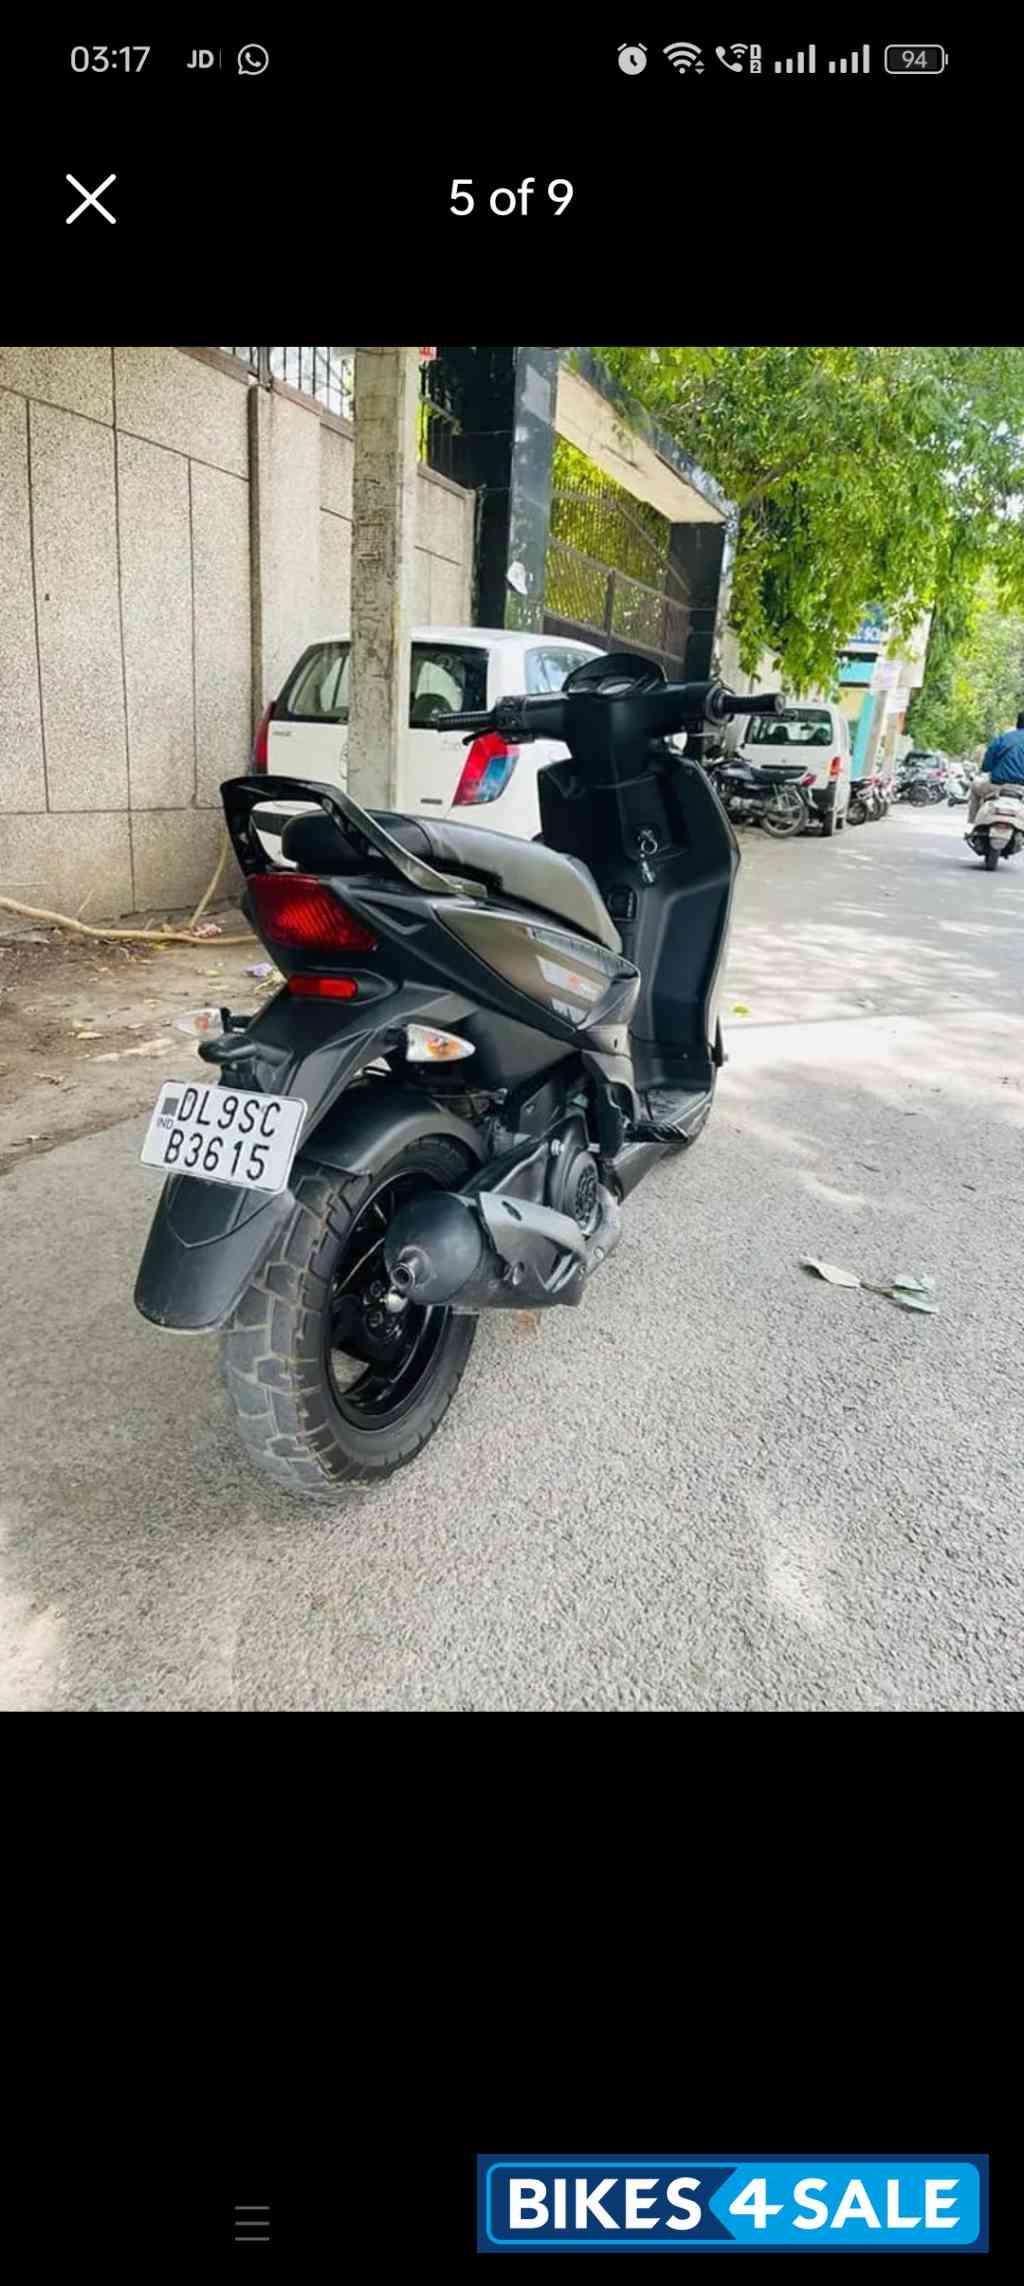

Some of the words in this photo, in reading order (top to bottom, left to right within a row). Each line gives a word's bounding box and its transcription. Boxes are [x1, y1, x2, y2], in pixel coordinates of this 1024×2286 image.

[157, 1117, 174, 1130] IND
[178, 1088, 281, 1137] DL9SC
[164, 1129, 270, 1181] B3615
